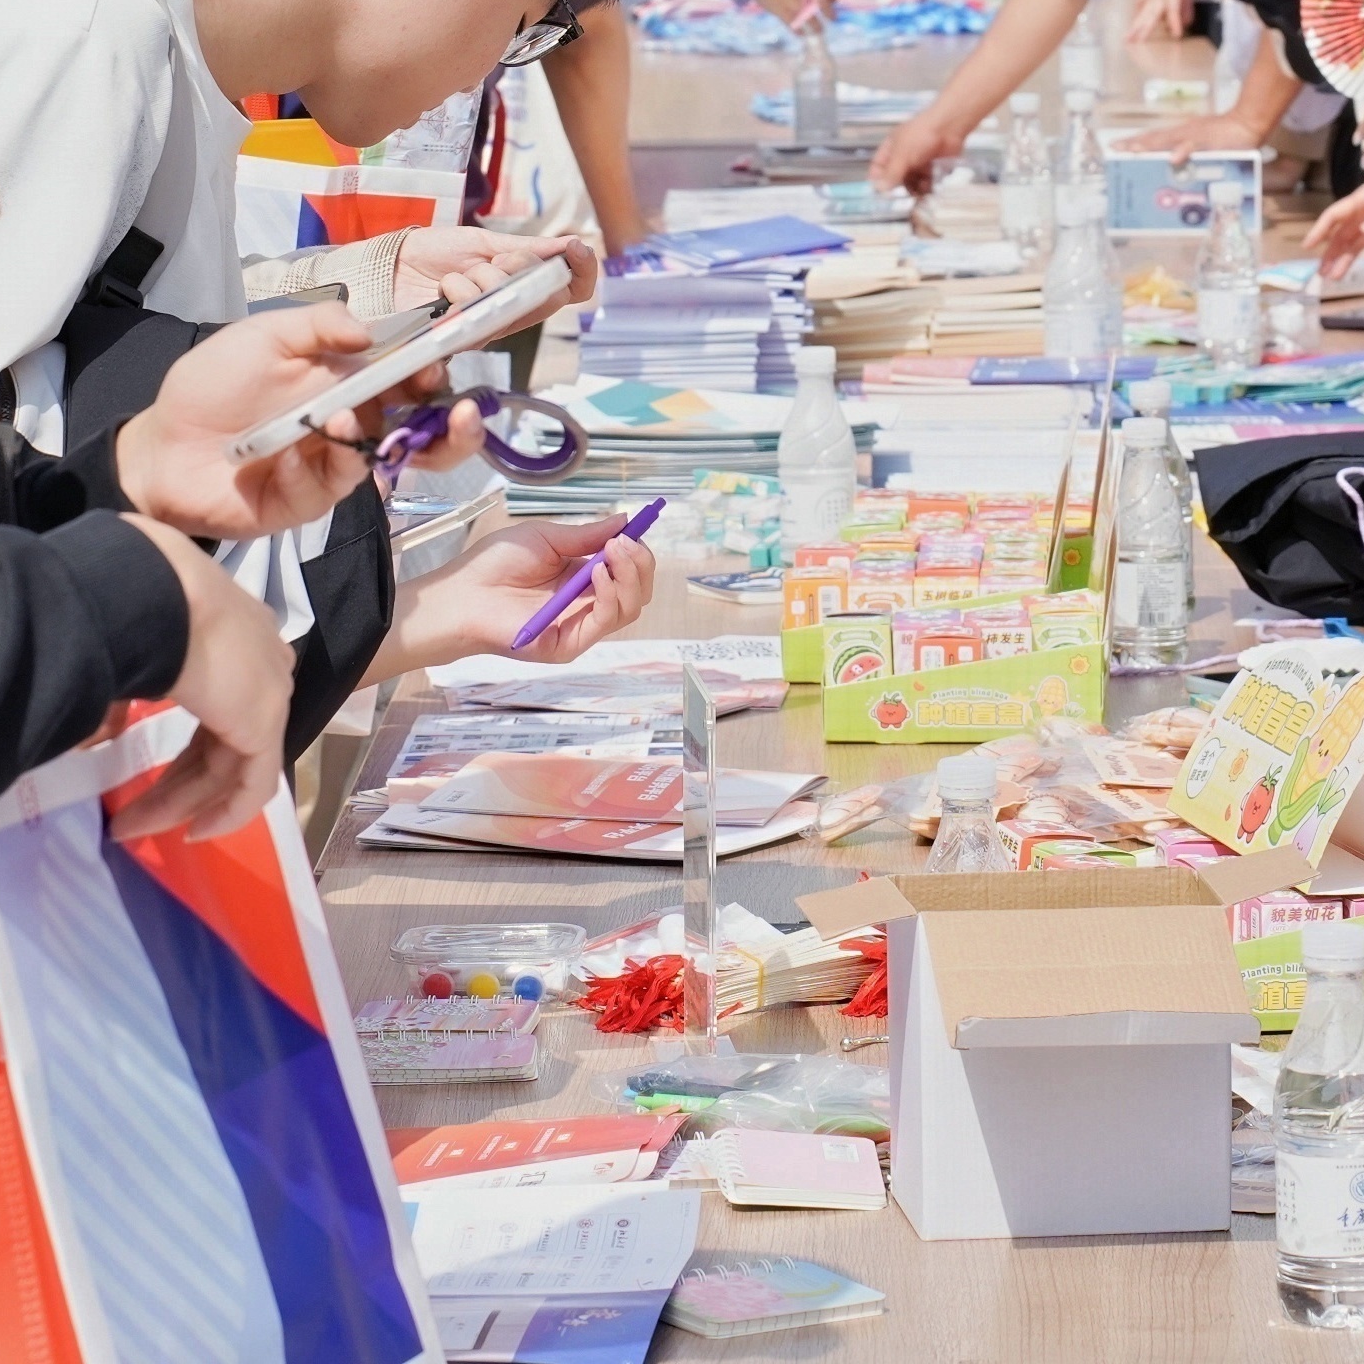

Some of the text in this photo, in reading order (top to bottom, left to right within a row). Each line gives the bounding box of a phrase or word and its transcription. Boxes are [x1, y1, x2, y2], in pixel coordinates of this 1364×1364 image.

[918, 702, 1023, 725] 种植盲盒
[1223, 674, 1315, 756] 种植盲盒
[1271, 906, 1335, 923] 貌美如花
[1286, 962, 1308, 973] blin
